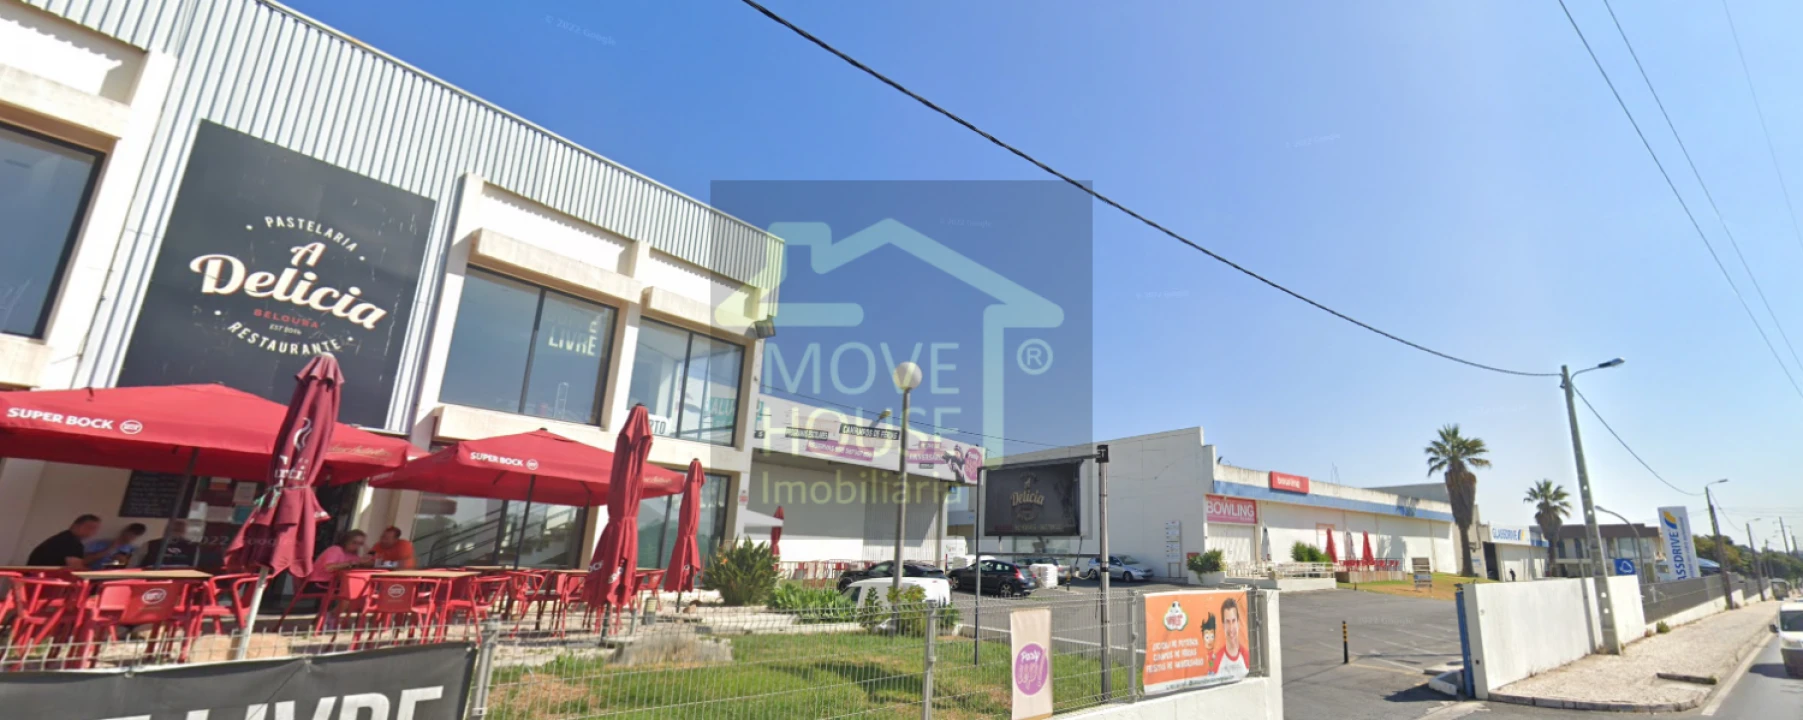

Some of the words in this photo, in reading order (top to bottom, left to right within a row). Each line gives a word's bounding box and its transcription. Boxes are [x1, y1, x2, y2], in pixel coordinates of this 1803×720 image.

[265, 216, 358, 252] PASTELARIA
[290, 242, 326, 267] A
[189, 254, 387, 329] Delicia
[253, 308, 319, 329] BELOURA
[227, 321, 342, 355] RESTAURANTE
[7, 407, 64, 423] SUPER
[65, 415, 115, 430] BOCK
[470, 452, 498, 464] SUPER
[499, 456, 524, 468] BOCK
[1207, 500, 1255, 518] BOWLING
